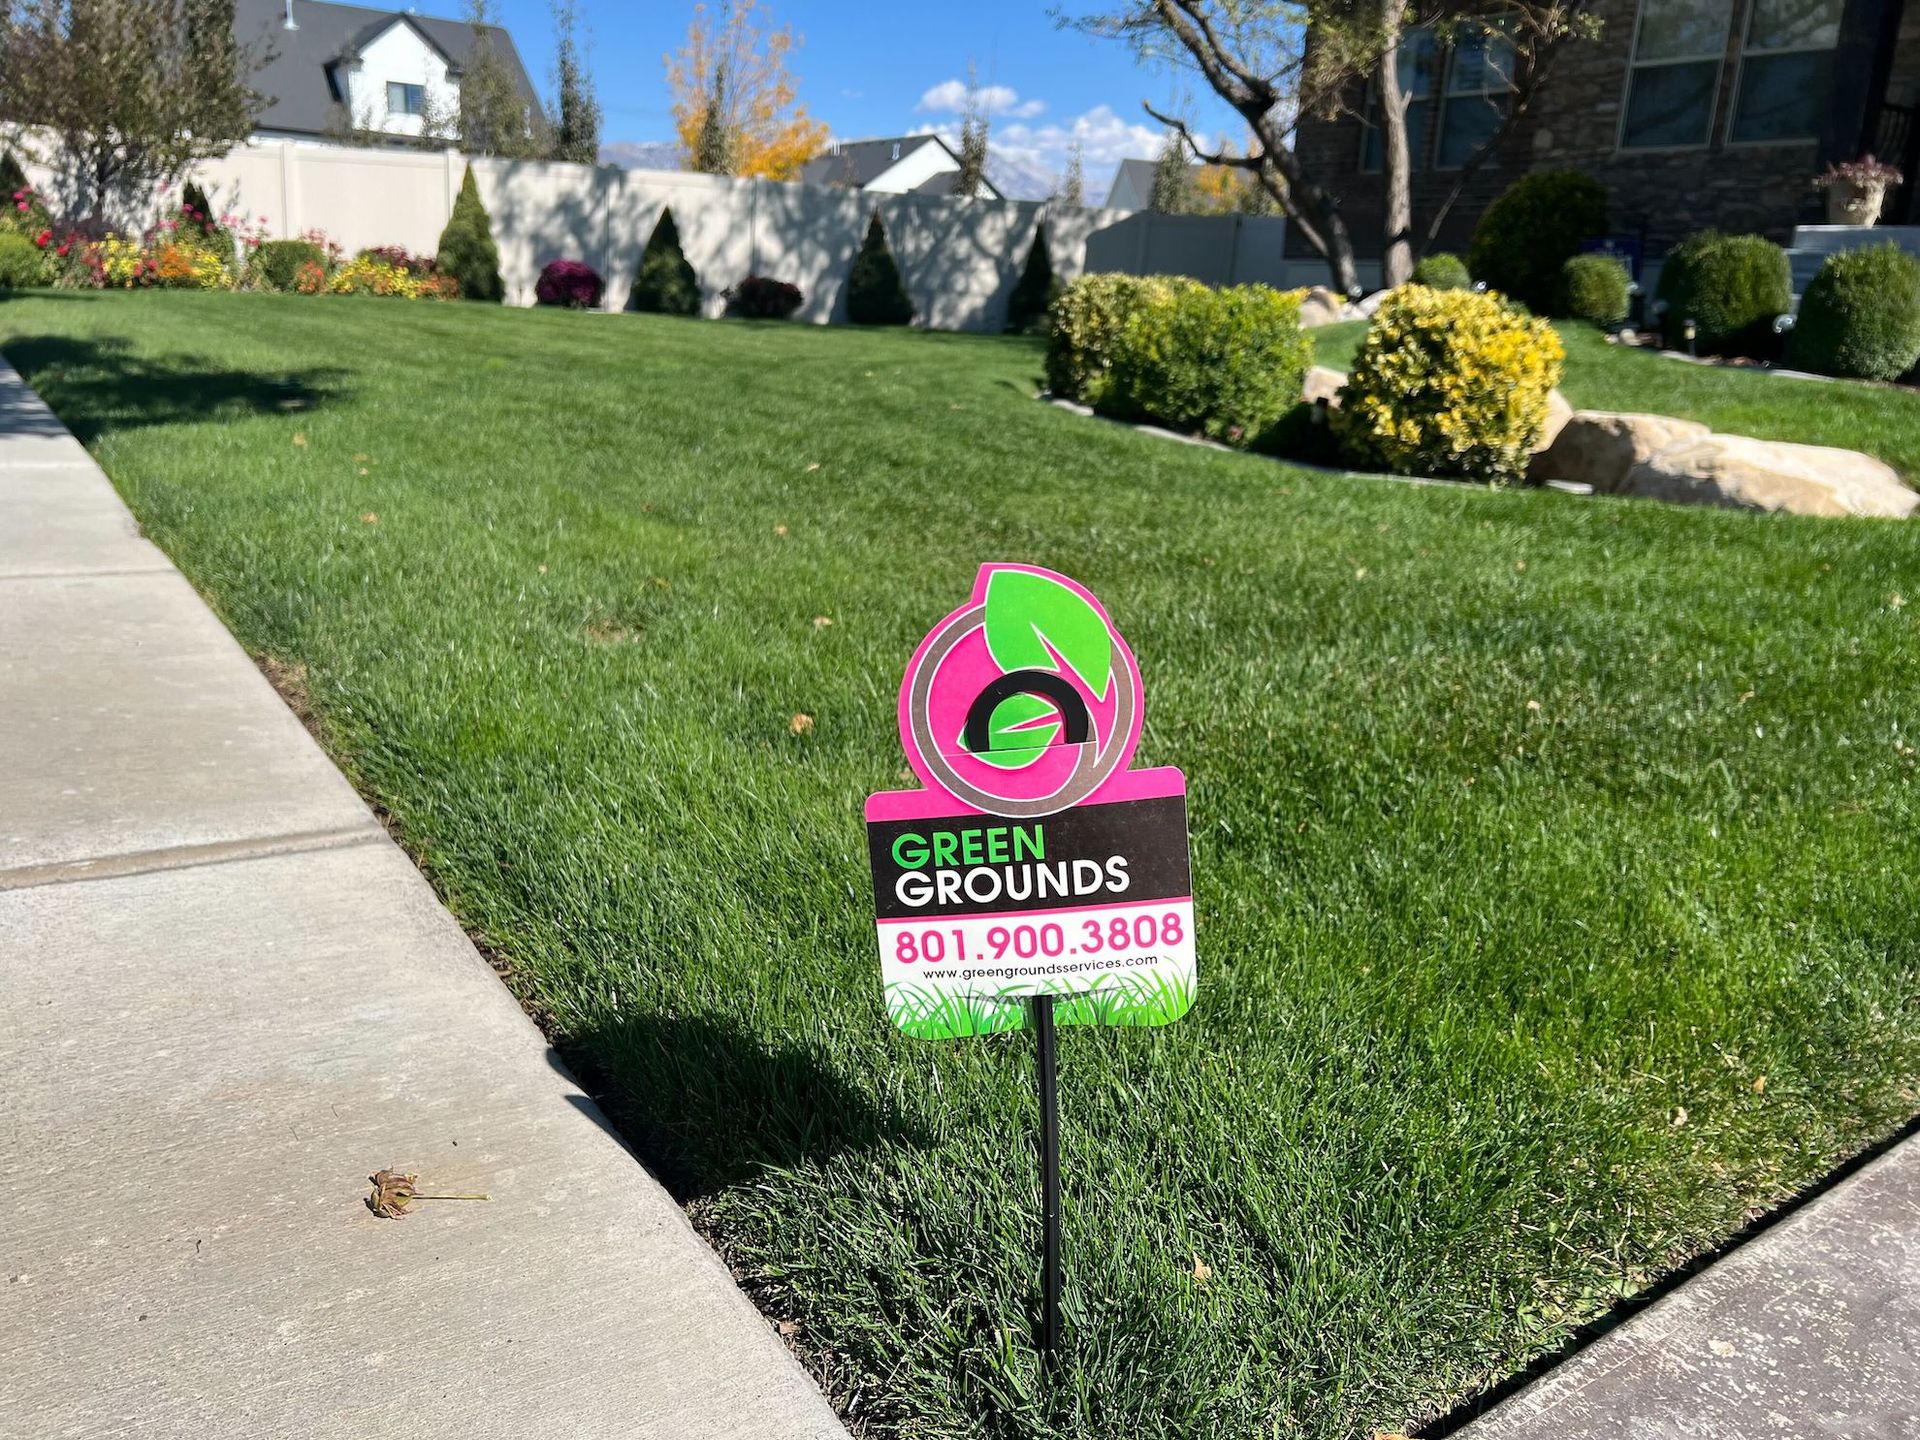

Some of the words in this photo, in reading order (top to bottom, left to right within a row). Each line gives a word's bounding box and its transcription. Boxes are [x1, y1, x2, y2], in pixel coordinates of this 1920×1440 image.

[891, 824, 1046, 870] GREEN
[895, 855, 1130, 907] GROUNDS
[895, 912, 1184, 964] 801.900.3808
[923, 954, 1158, 981] www.greengroundsservices.com
